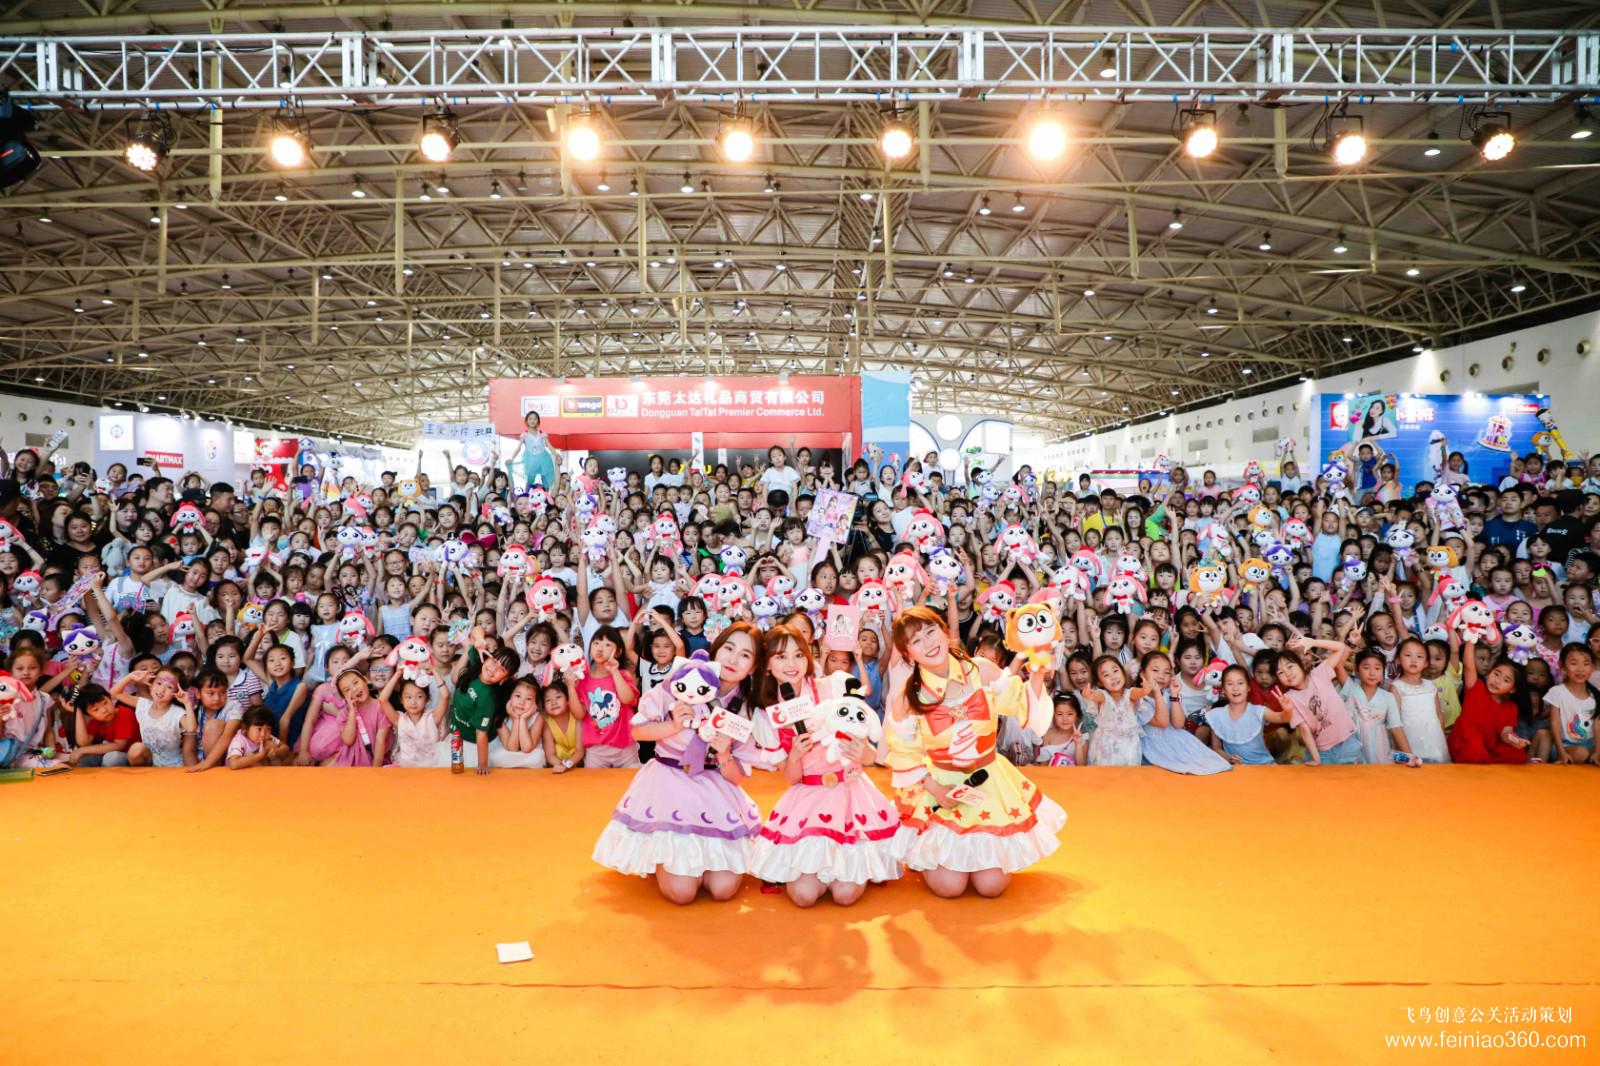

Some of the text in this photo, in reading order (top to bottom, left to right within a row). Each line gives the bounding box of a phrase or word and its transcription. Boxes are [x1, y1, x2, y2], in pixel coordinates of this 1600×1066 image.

[642, 390, 825, 405] 东莞太达礼品商贸有限公司
[641, 408, 688, 419] Dongguan
[719, 408, 754, 417] Premier
[756, 408, 805, 417] Commerce
[807, 408, 825, 417] Ltd.
